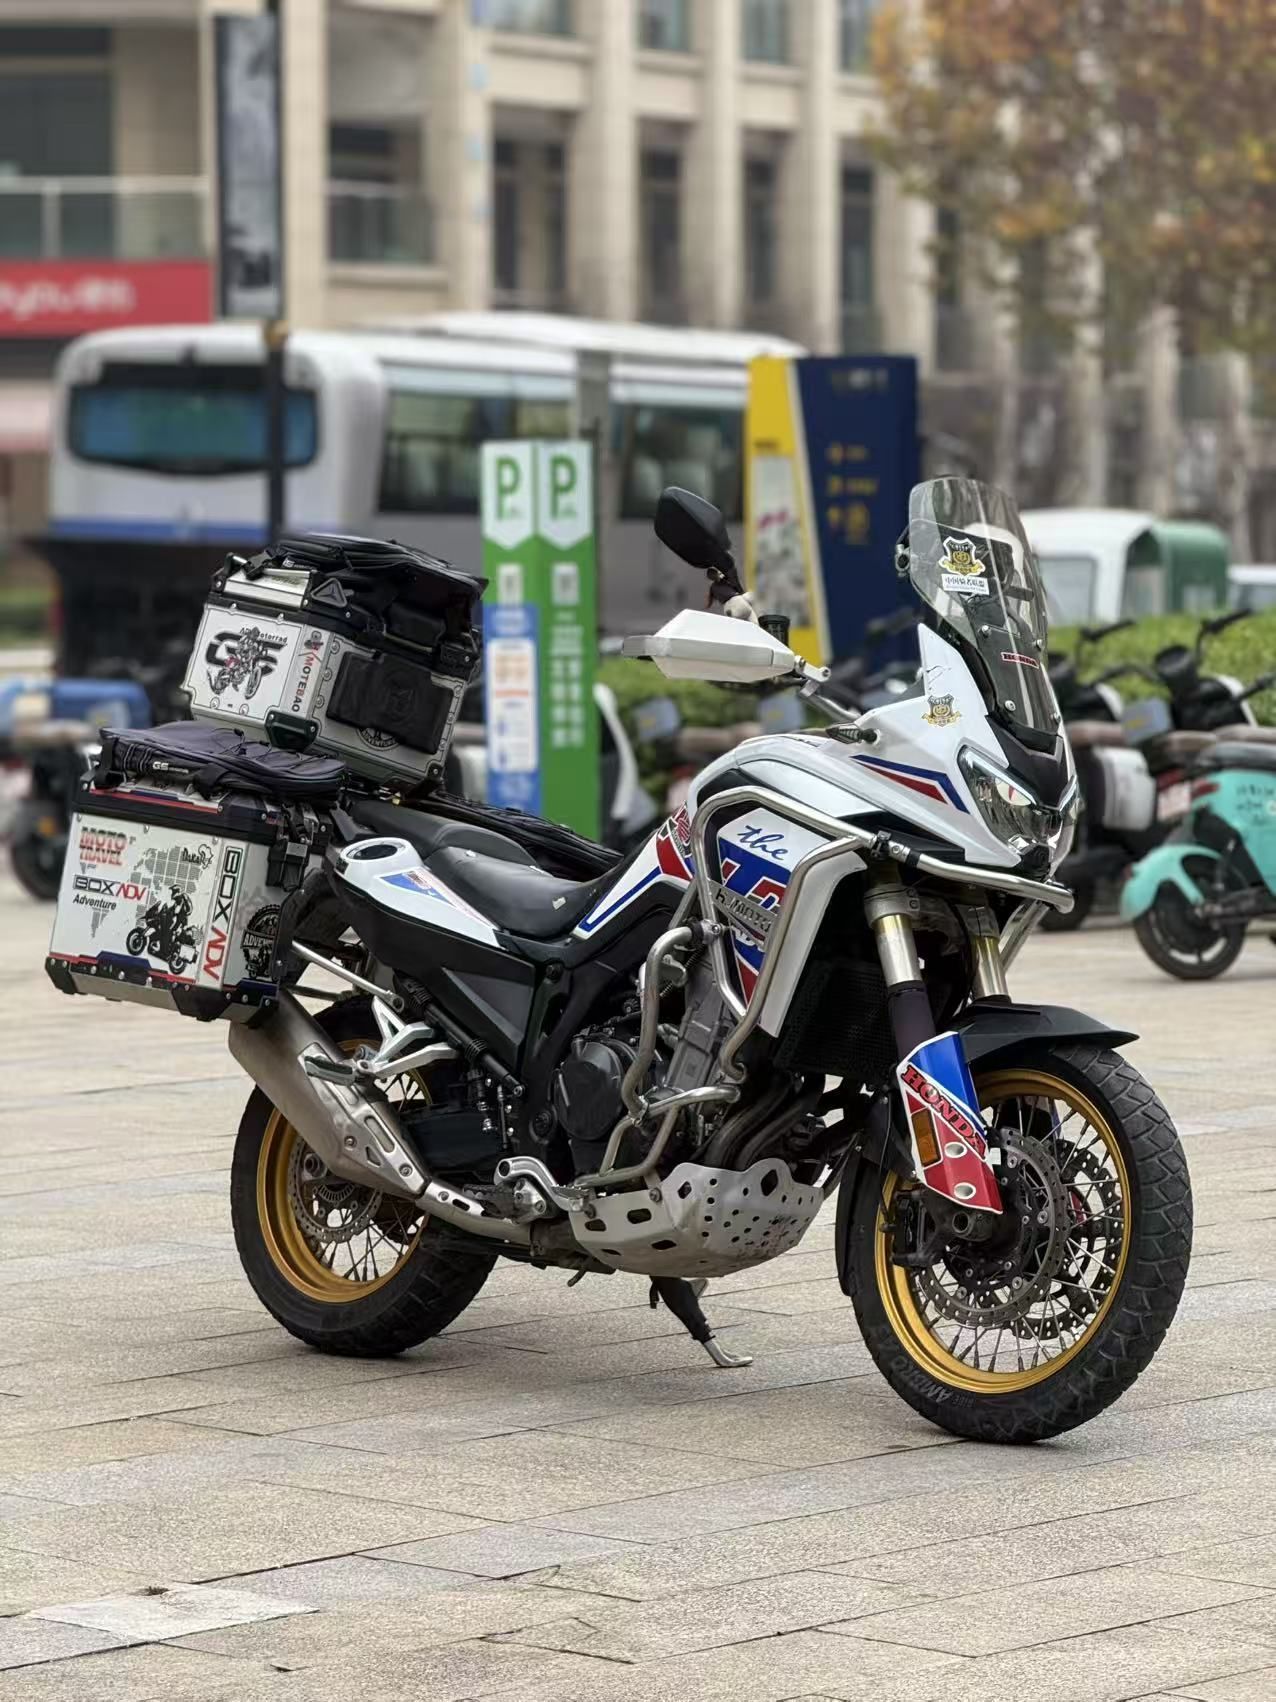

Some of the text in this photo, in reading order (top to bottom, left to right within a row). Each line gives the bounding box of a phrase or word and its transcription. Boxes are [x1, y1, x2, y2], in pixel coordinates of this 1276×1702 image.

[496, 456, 521, 520] P
[551, 456, 577, 520] P
[291, 656, 315, 712] MOTEBAO
[79, 826, 128, 851] MOTO
[79, 844, 123, 866] TRAVEL
[737, 825, 789, 861] the
[73, 894, 117, 910] Adventure
[900, 1064, 987, 1160] HONDA
